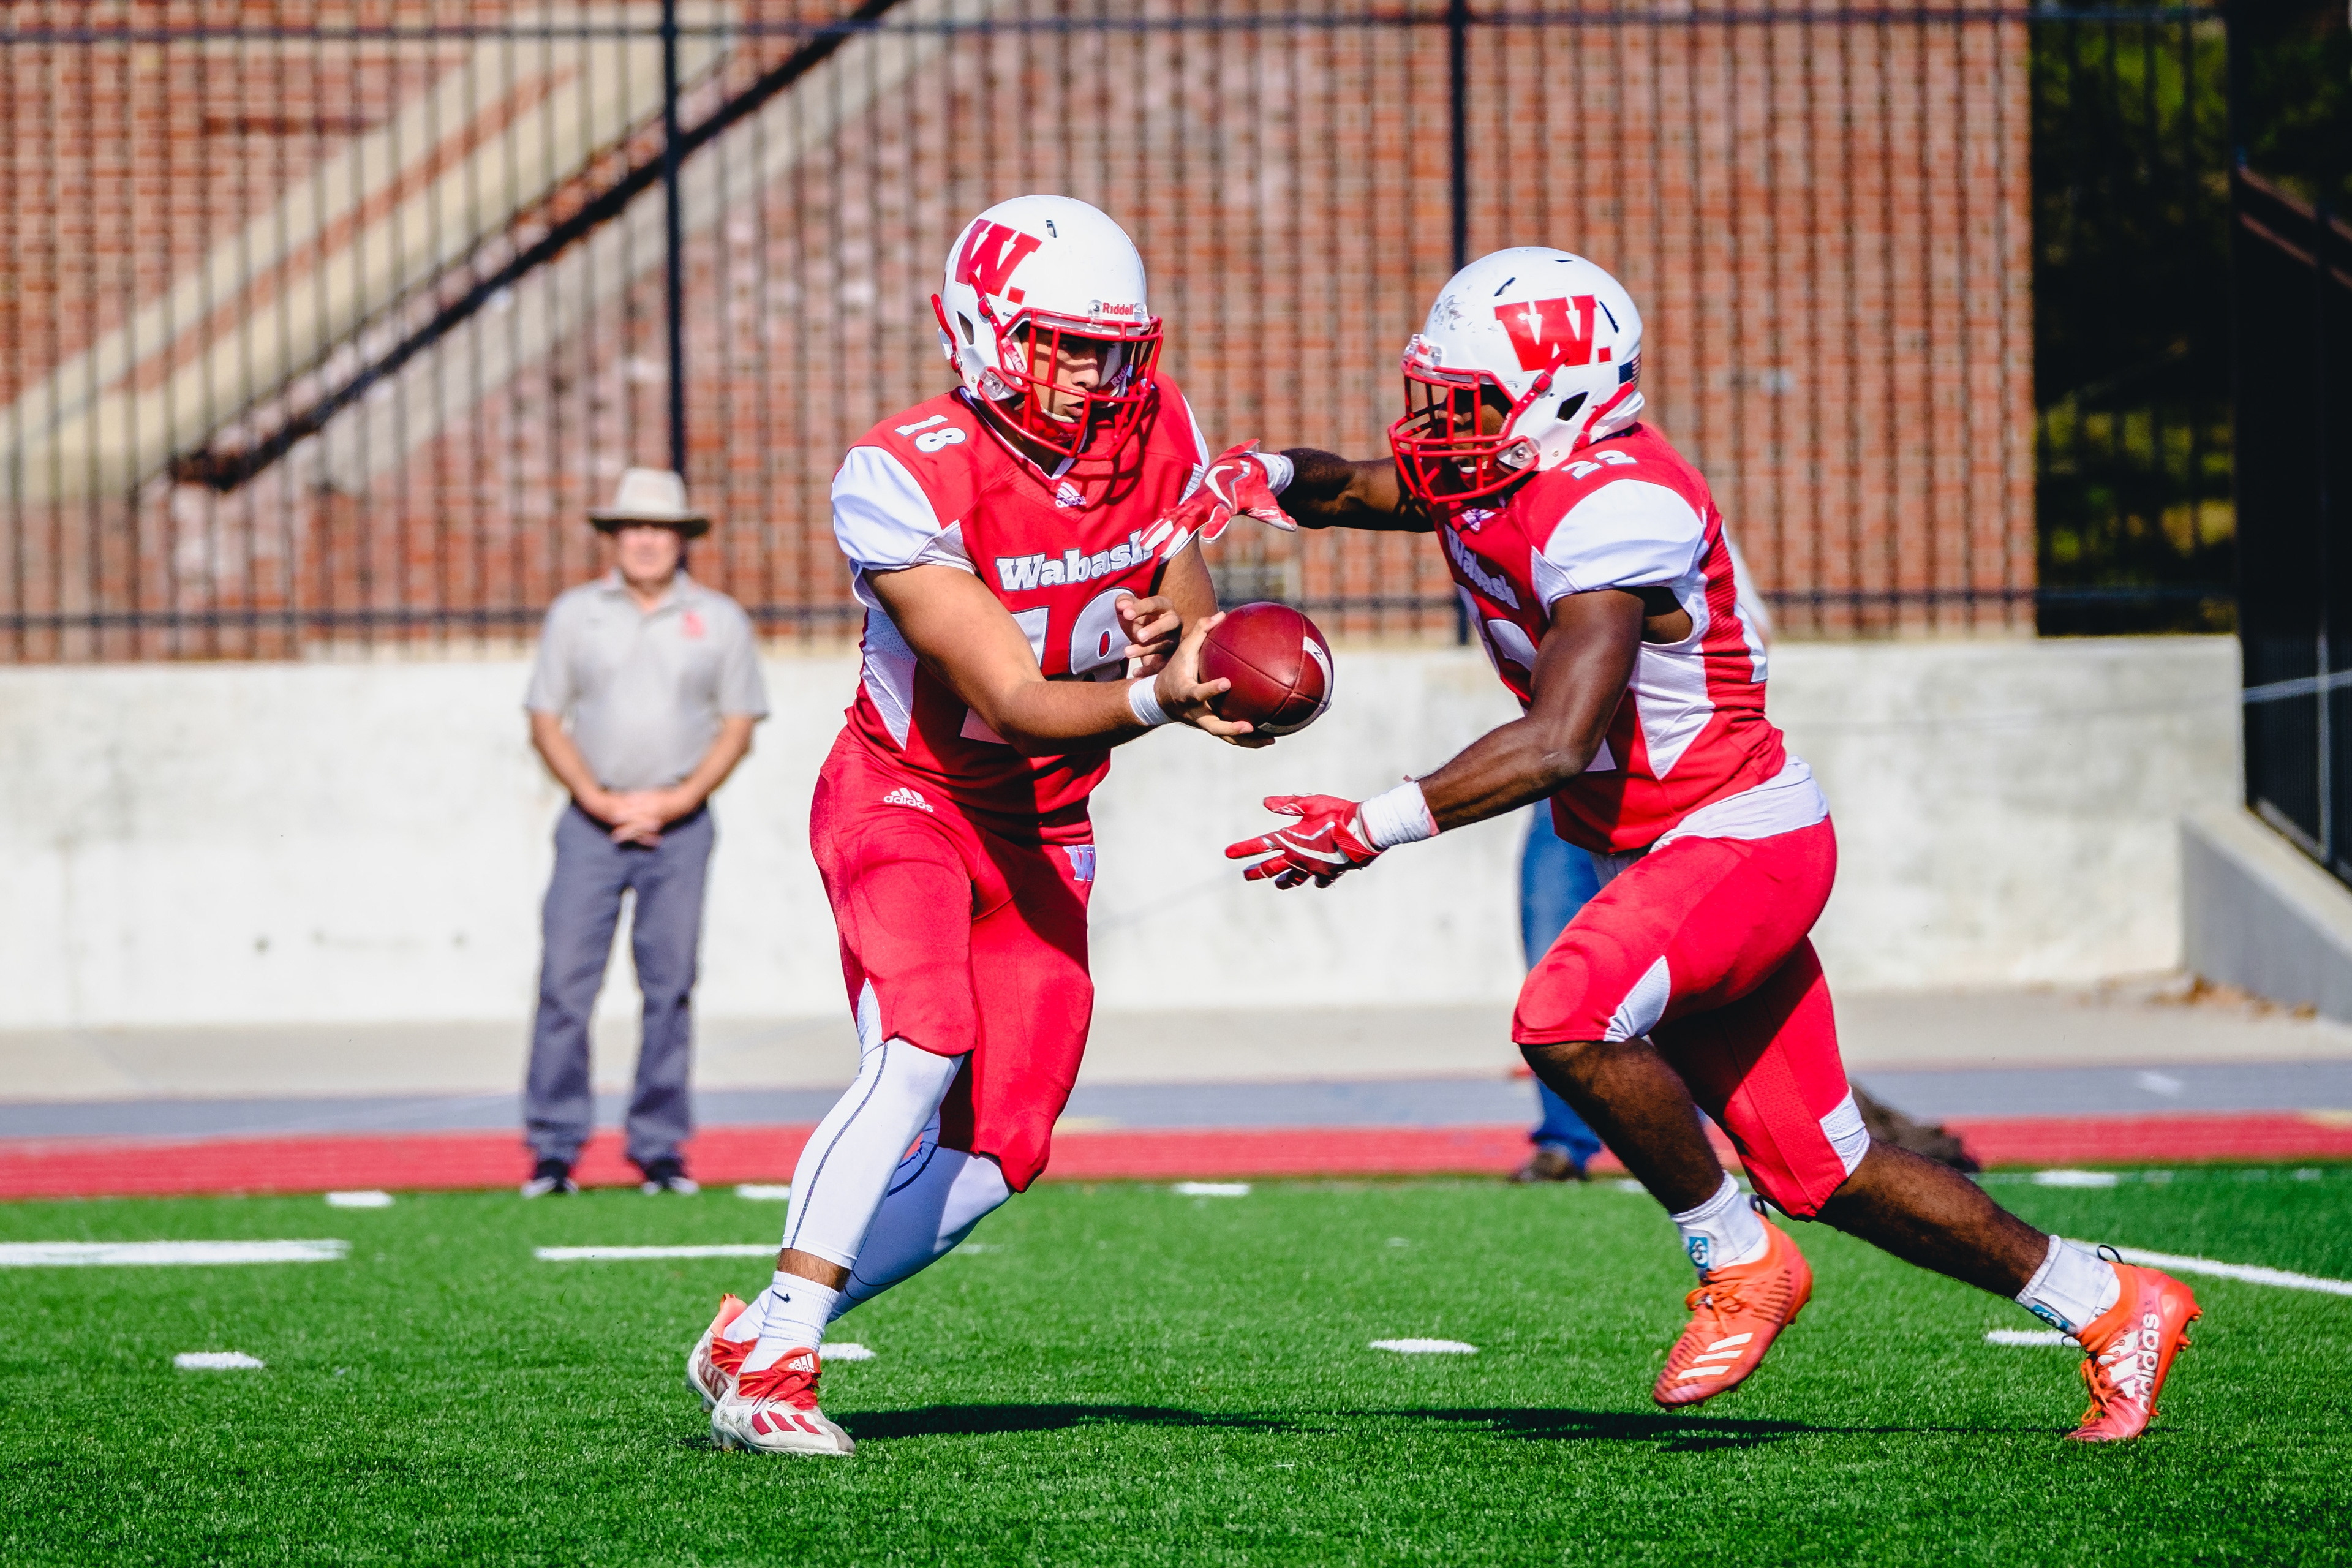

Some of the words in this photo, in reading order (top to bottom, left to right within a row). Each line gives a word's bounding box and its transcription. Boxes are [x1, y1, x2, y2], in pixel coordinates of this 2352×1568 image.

[1102, 302, 1134, 315] Riddell
[894, 414, 967, 453] 18
[1561, 450, 1637, 480] 22
[883, 796, 934, 813] adidas
[1063, 845, 1096, 881] W
[2135, 1314, 2160, 1414] adidas
